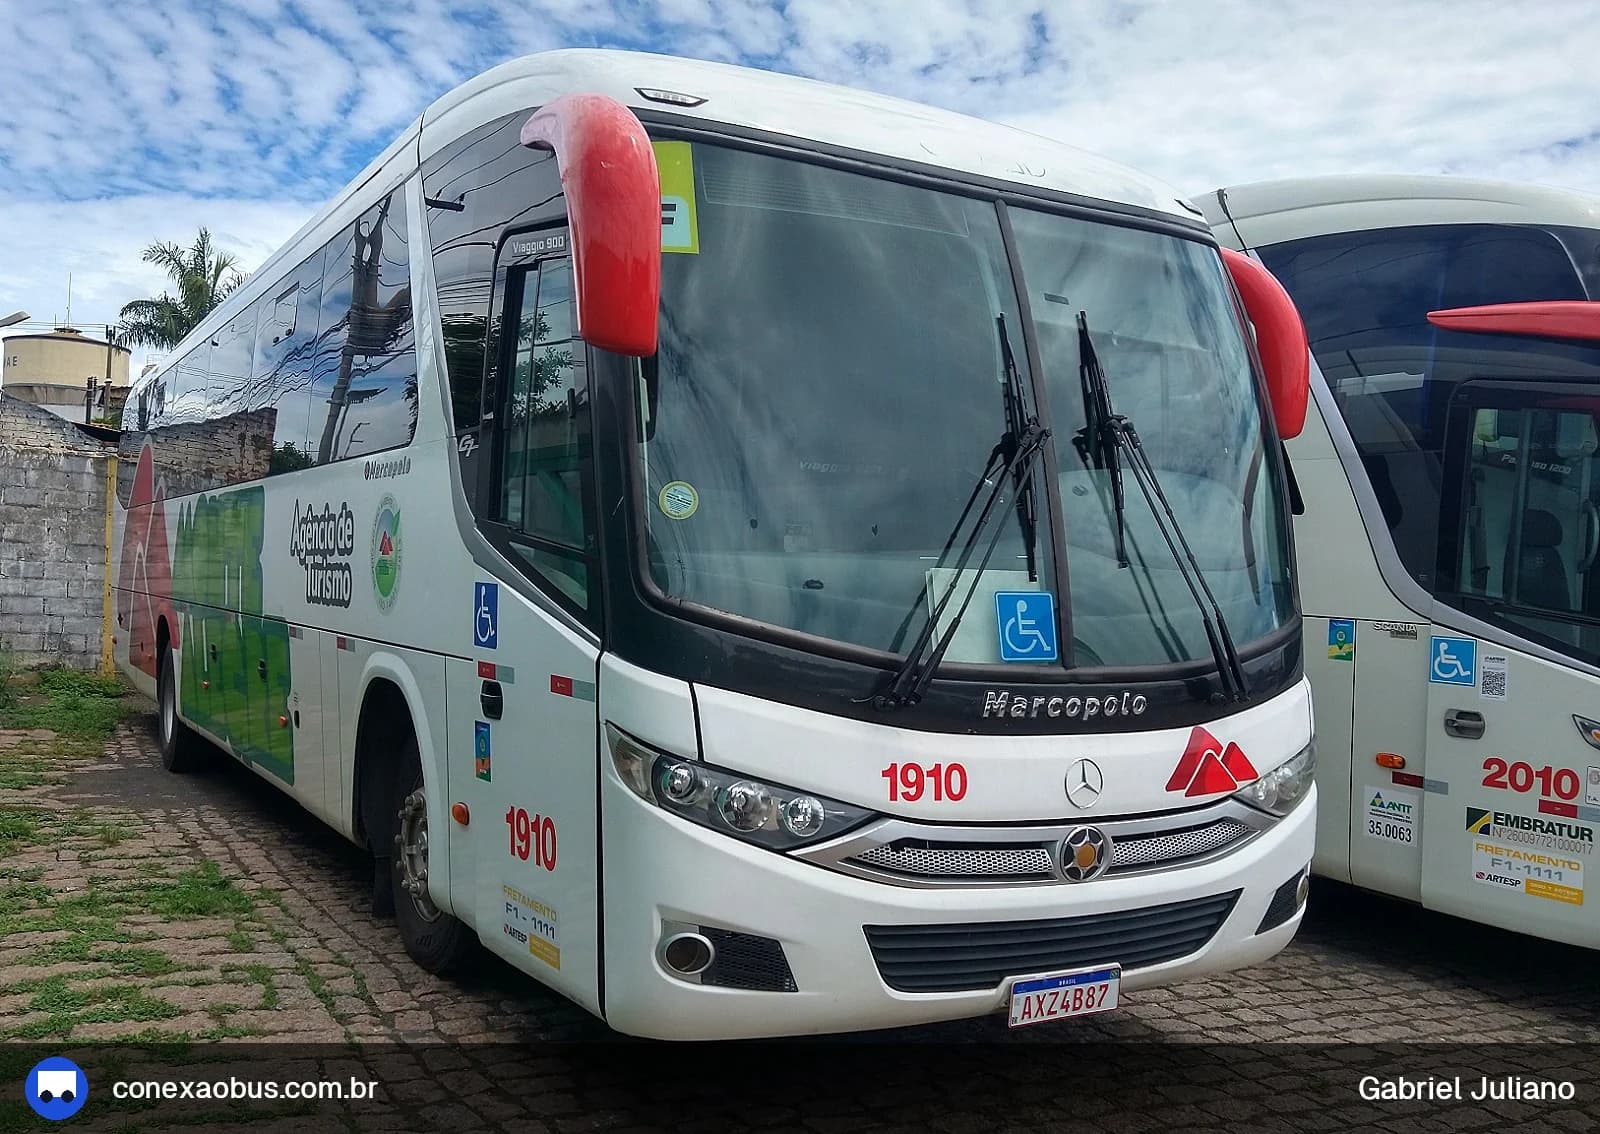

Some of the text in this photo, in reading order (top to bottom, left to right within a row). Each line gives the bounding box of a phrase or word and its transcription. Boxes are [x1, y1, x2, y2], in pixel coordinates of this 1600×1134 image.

[513, 236, 564, 255] Viaggio 900
[369, 455, 411, 480] Marcopolo
[290, 498, 336, 565] Agência
[336, 501, 353, 556] de
[305, 557, 352, 608] Turismo
[1373, 621, 1417, 632] SCANIA
[983, 691, 1147, 720] Marcopolo
[881, 762, 968, 802] 1910
[1481, 756, 1580, 800] 2010
[1386, 801, 1412, 814] ANTT
[505, 805, 557, 872] 1910
[1368, 819, 1412, 843] 35.0063
[1493, 811, 1593, 842] EMBRATUR
[1475, 843, 1581, 871] FRETAMENTO
[1491, 857, 1563, 881] F1-1111
[1485, 873, 1521, 888] ARTESP
[503, 884, 557, 922] FRETAMENTO
[508, 926, 528, 944] ARTESP
[1021, 983, 1109, 1020] AXZ4B87
